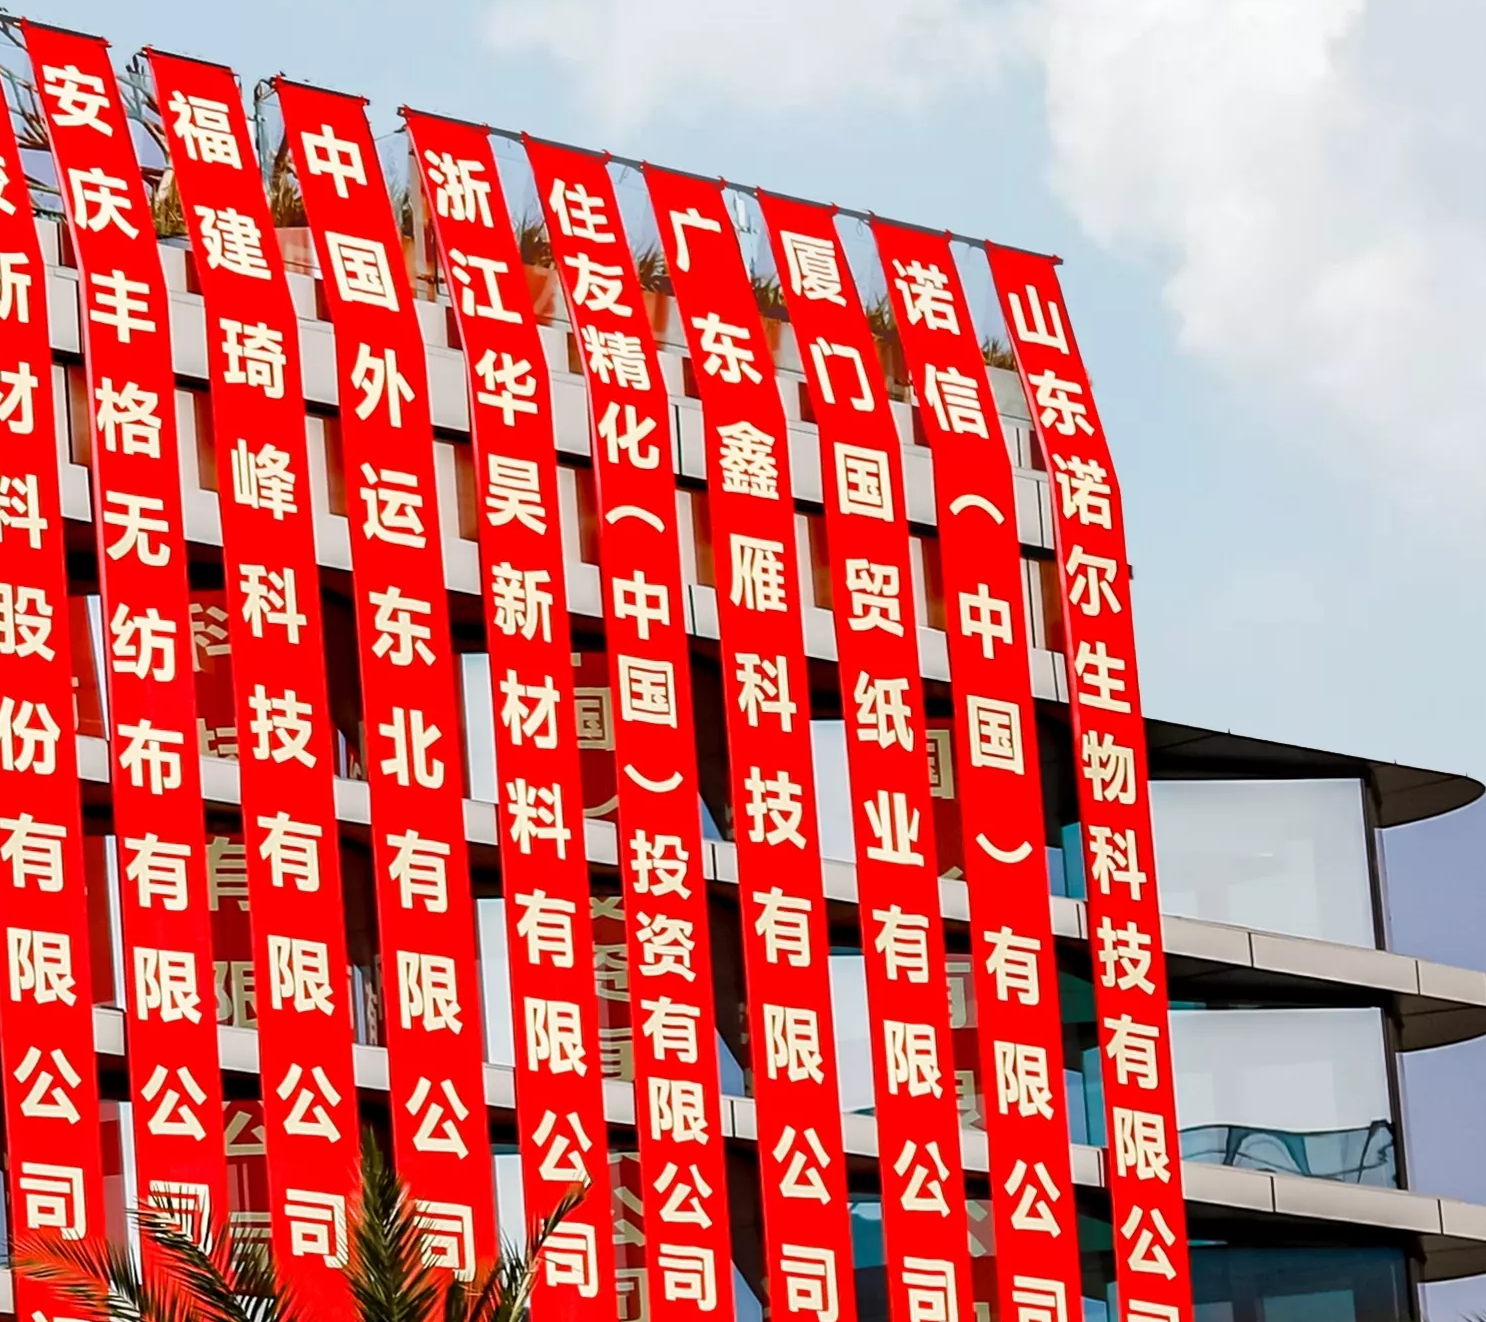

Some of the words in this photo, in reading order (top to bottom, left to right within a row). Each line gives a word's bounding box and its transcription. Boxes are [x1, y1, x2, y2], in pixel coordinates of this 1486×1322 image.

[46, 66, 210, 1242] 安庆丰格无纺布有限公司
[169, 97, 349, 1269] 福建琦峰科技有限公司
[302, 124, 476, 1282] 中国外运东北有限公司
[413, 150, 599, 1298] 浙江华昊新材料有限公司
[551, 179, 717, 1311] 住友精化（中国）投资有限公司
